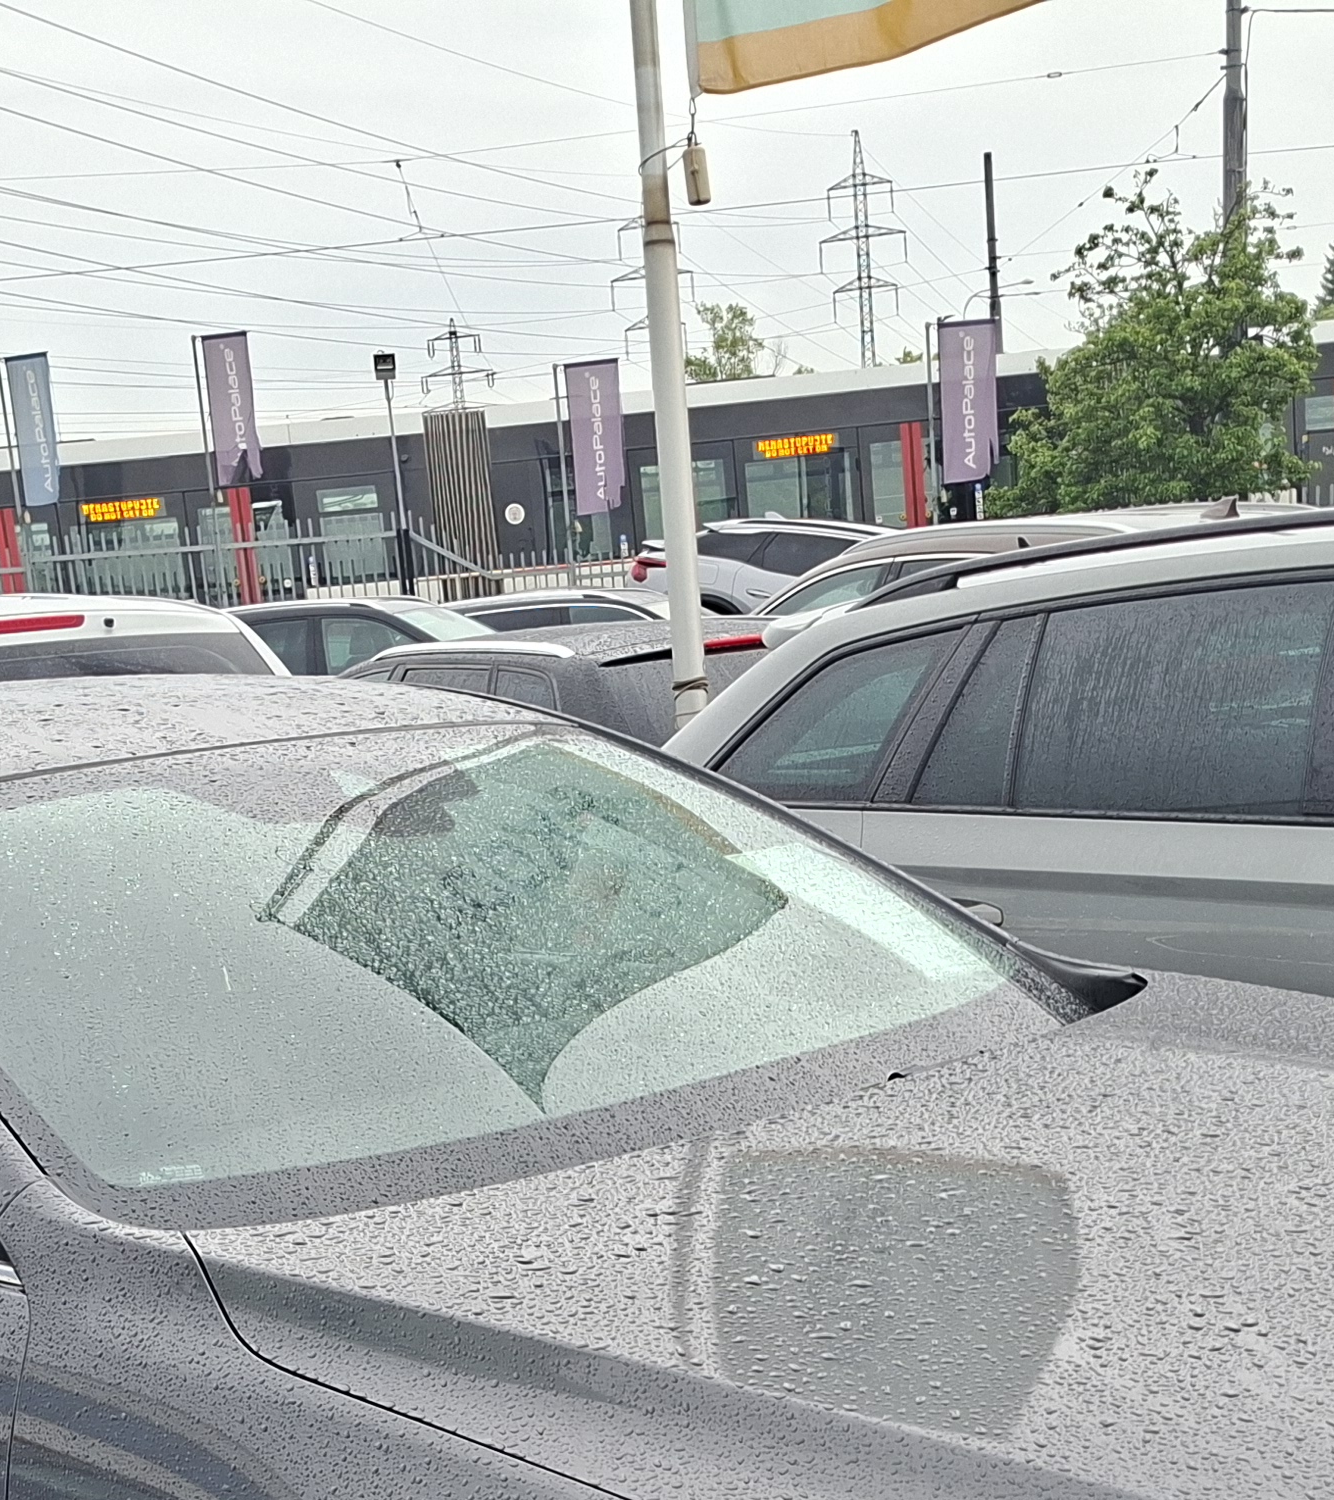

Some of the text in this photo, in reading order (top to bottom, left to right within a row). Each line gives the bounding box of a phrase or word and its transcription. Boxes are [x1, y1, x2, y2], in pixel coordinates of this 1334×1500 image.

[26, 370, 54, 493] AutoPalace
[224, 348, 247, 466] toPalace
[589, 376, 607, 500] AutoPalace
[962, 336, 977, 469] AutoPalace
